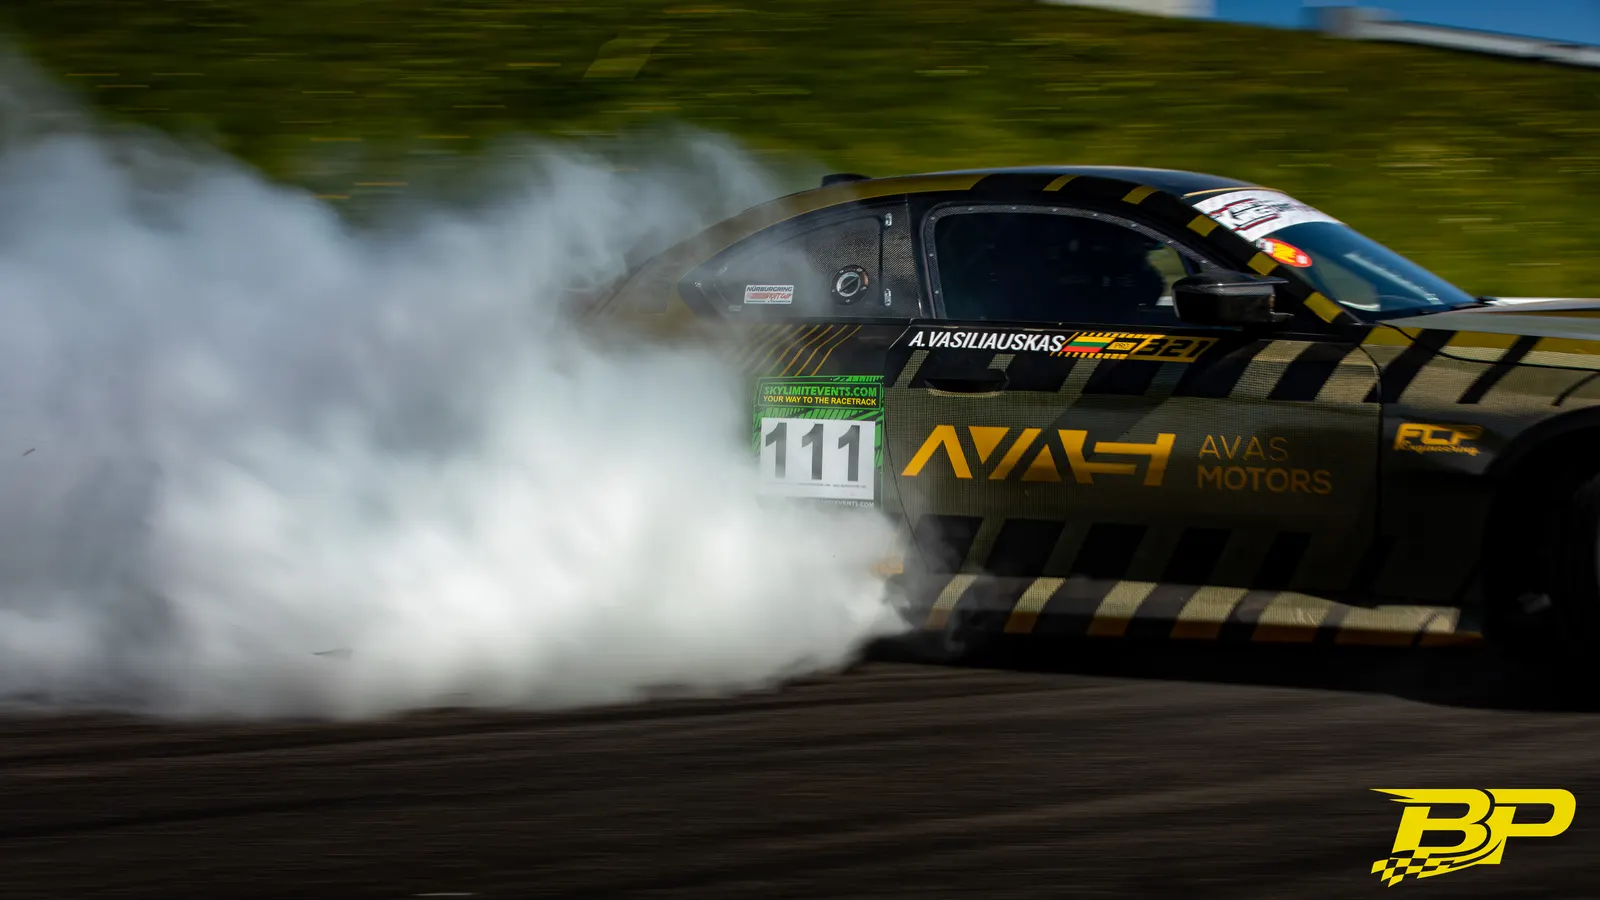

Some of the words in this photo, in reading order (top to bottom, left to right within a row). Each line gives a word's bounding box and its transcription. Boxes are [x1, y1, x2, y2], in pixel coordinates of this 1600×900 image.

[908, 331, 1067, 353] A.VASILIAUSKAS
[1134, 338, 1209, 357] 321
[763, 395, 784, 403] YOUR
[803, 396, 813, 404] TO
[831, 397, 877, 406] RACETRACK
[764, 386, 877, 397] SKYLIMITEVENTS.COM
[1199, 434, 1288, 461] AVAS
[1393, 423, 1484, 450] FCP
[765, 422, 860, 482] 111
[1197, 464, 1333, 495] MOTORS
